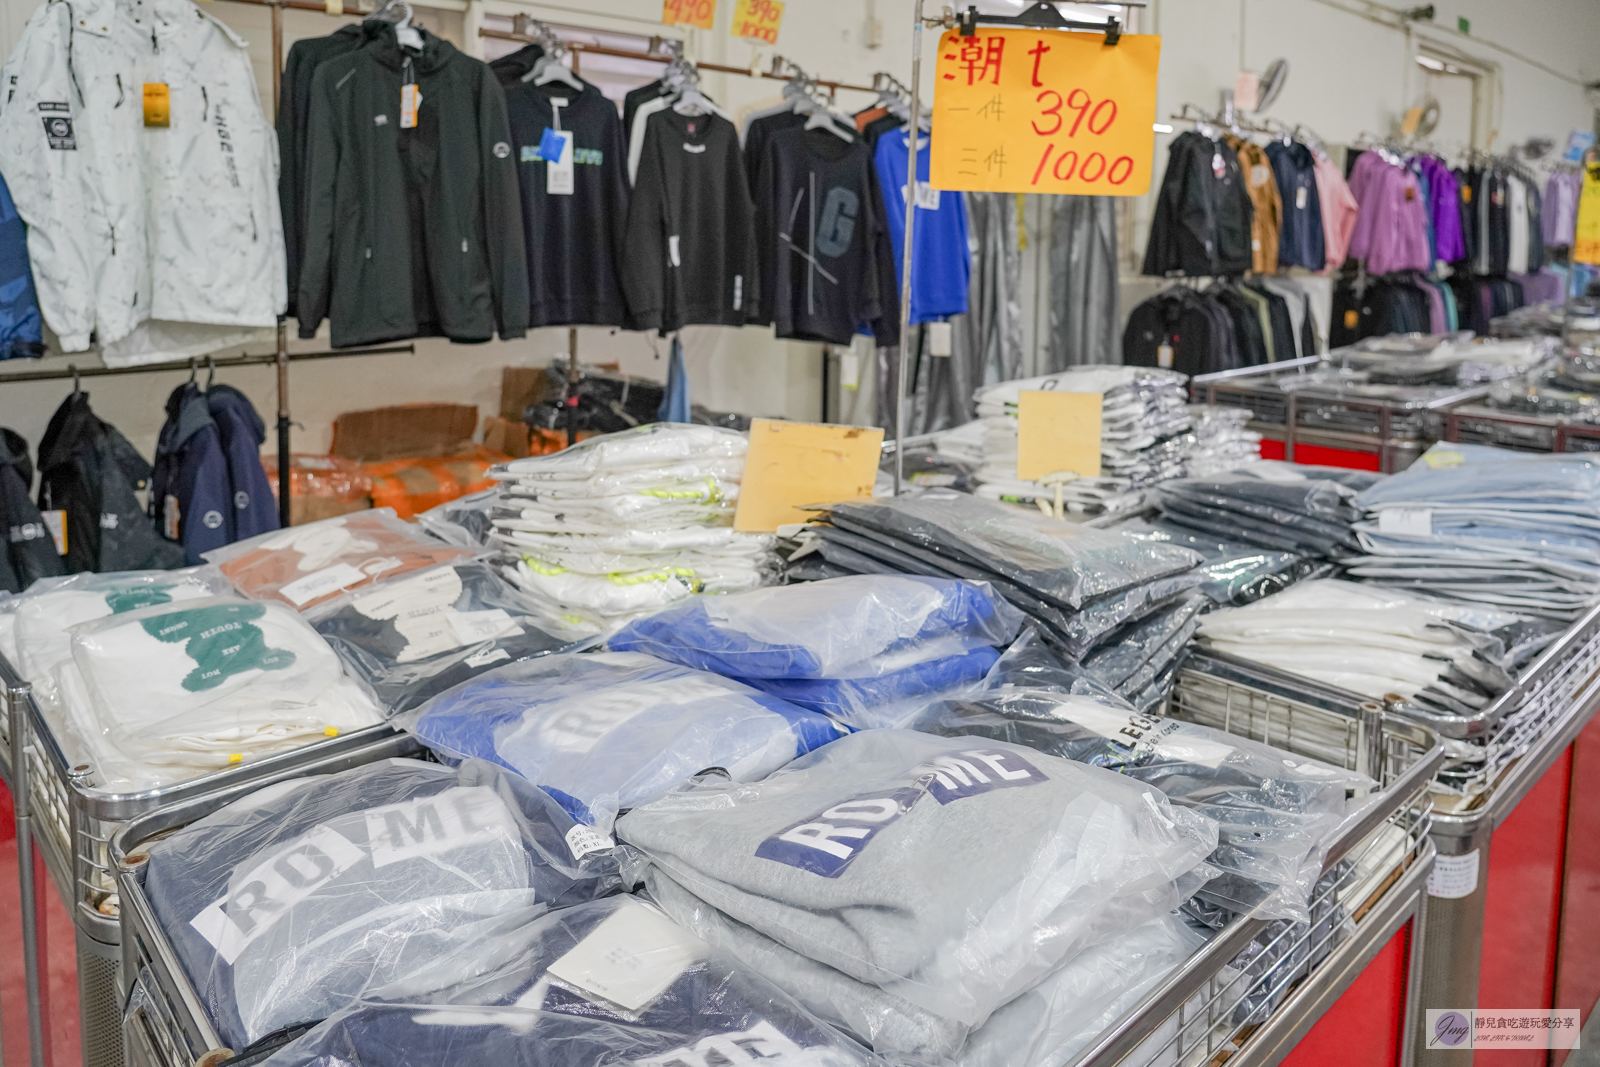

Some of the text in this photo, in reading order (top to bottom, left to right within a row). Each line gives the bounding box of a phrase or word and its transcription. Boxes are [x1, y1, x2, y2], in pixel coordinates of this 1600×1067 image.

[747, 0, 780, 24] 390
[740, 21, 778, 45] 1000
[943, 34, 1051, 87] 潮 t
[948, 88, 1118, 138] 一件 390
[958, 143, 1134, 186] 三件 1000
[200, 622, 243, 639] YOUTH
[221, 645, 241, 656] ARE
[201, 668, 221, 680] NOT
